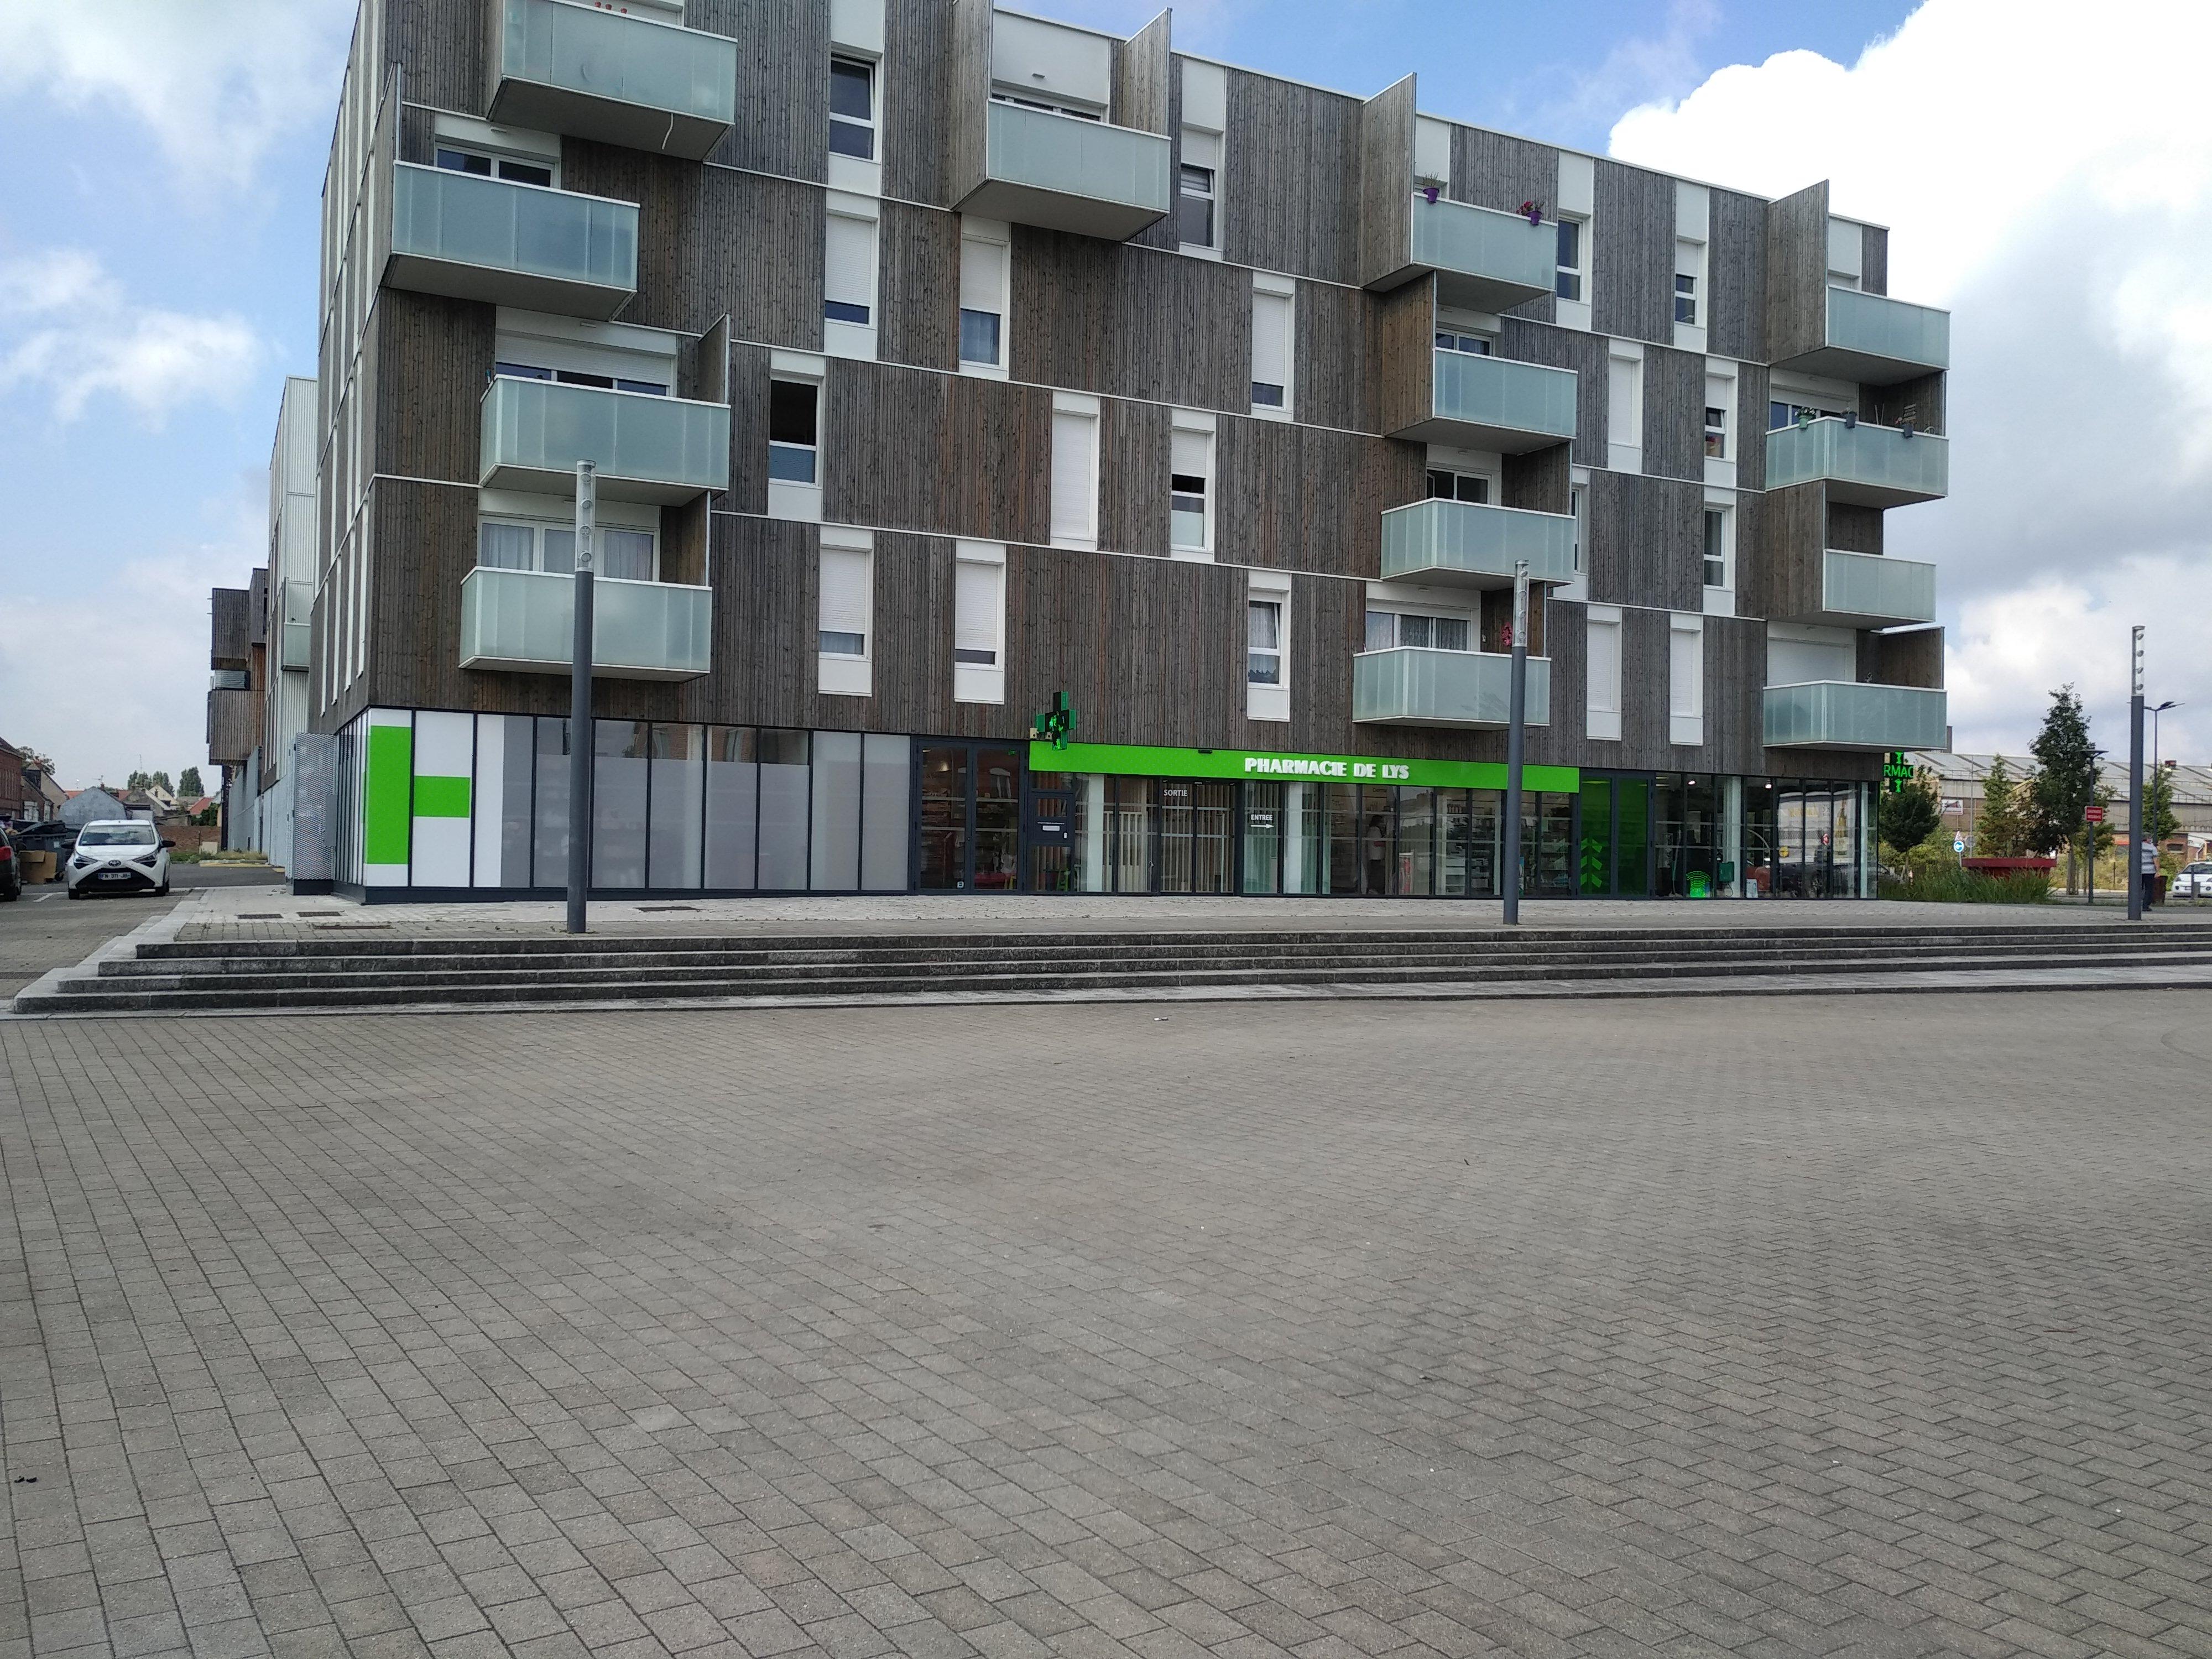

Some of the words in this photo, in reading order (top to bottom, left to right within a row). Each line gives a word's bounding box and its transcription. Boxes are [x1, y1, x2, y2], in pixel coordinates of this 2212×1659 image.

[1245, 758, 1347, 776] PHARMACIE
[1353, 763, 1376, 778] DE
[1382, 764, 1409, 779] LYS
